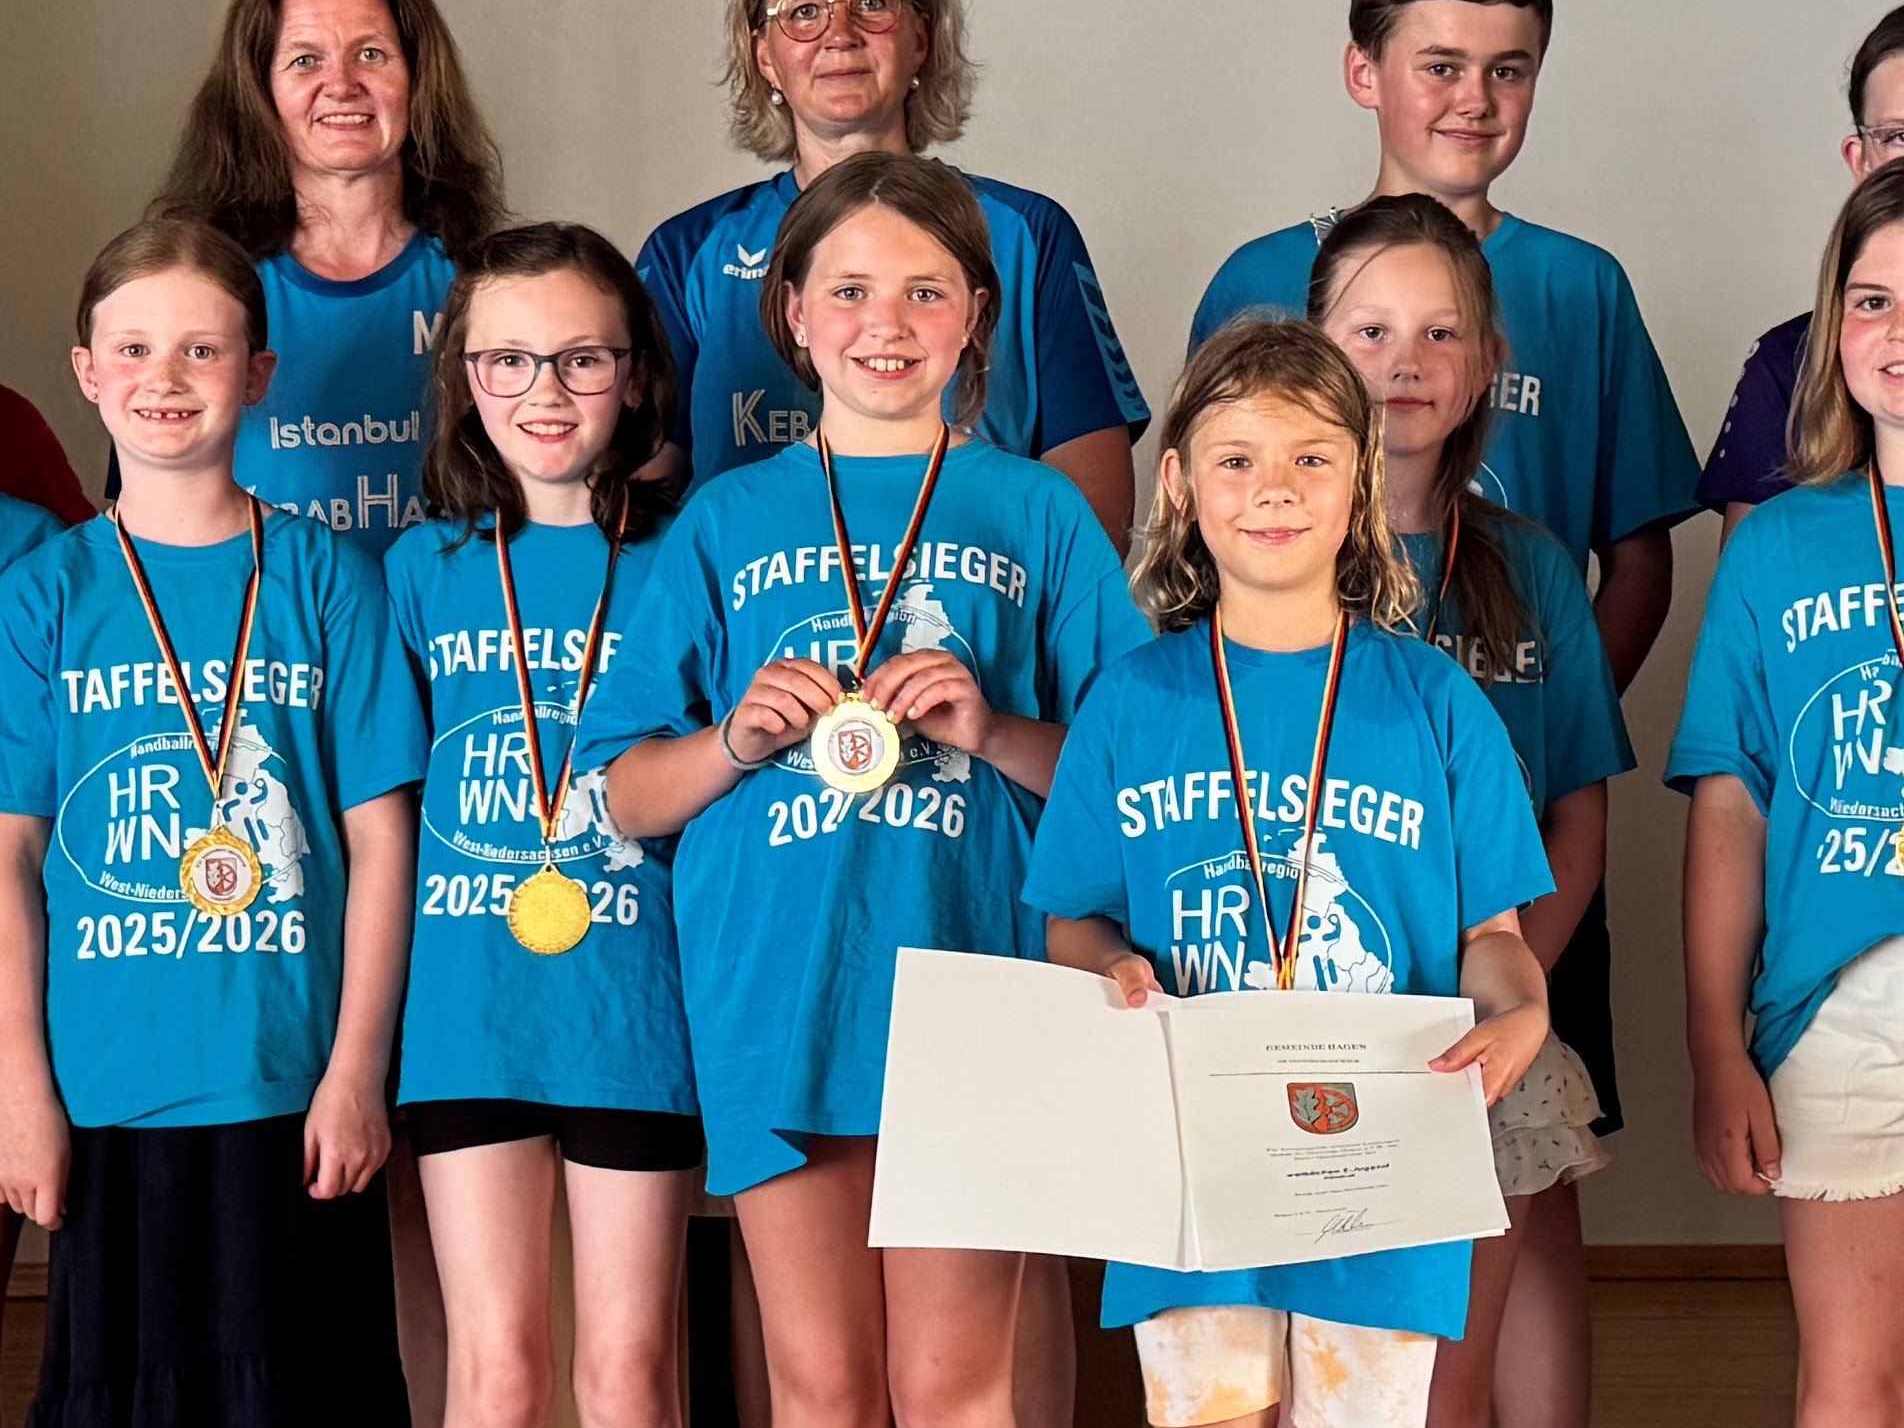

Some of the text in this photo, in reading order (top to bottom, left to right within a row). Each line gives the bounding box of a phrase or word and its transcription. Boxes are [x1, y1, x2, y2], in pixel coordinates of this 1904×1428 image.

[412, 309, 444, 355] M
[269, 410, 420, 450] Istanbul
[731, 388, 812, 447] KEB
[462, 730, 533, 778] HR
[107, 763, 181, 819] HR
[458, 777, 528, 826] WN
[767, 782, 968, 848] 202/2026
[103, 812, 182, 866] WN
[76, 909, 307, 961] 2025/2026
[1171, 883, 1251, 942] HR
[1170, 939, 1247, 997] WN
